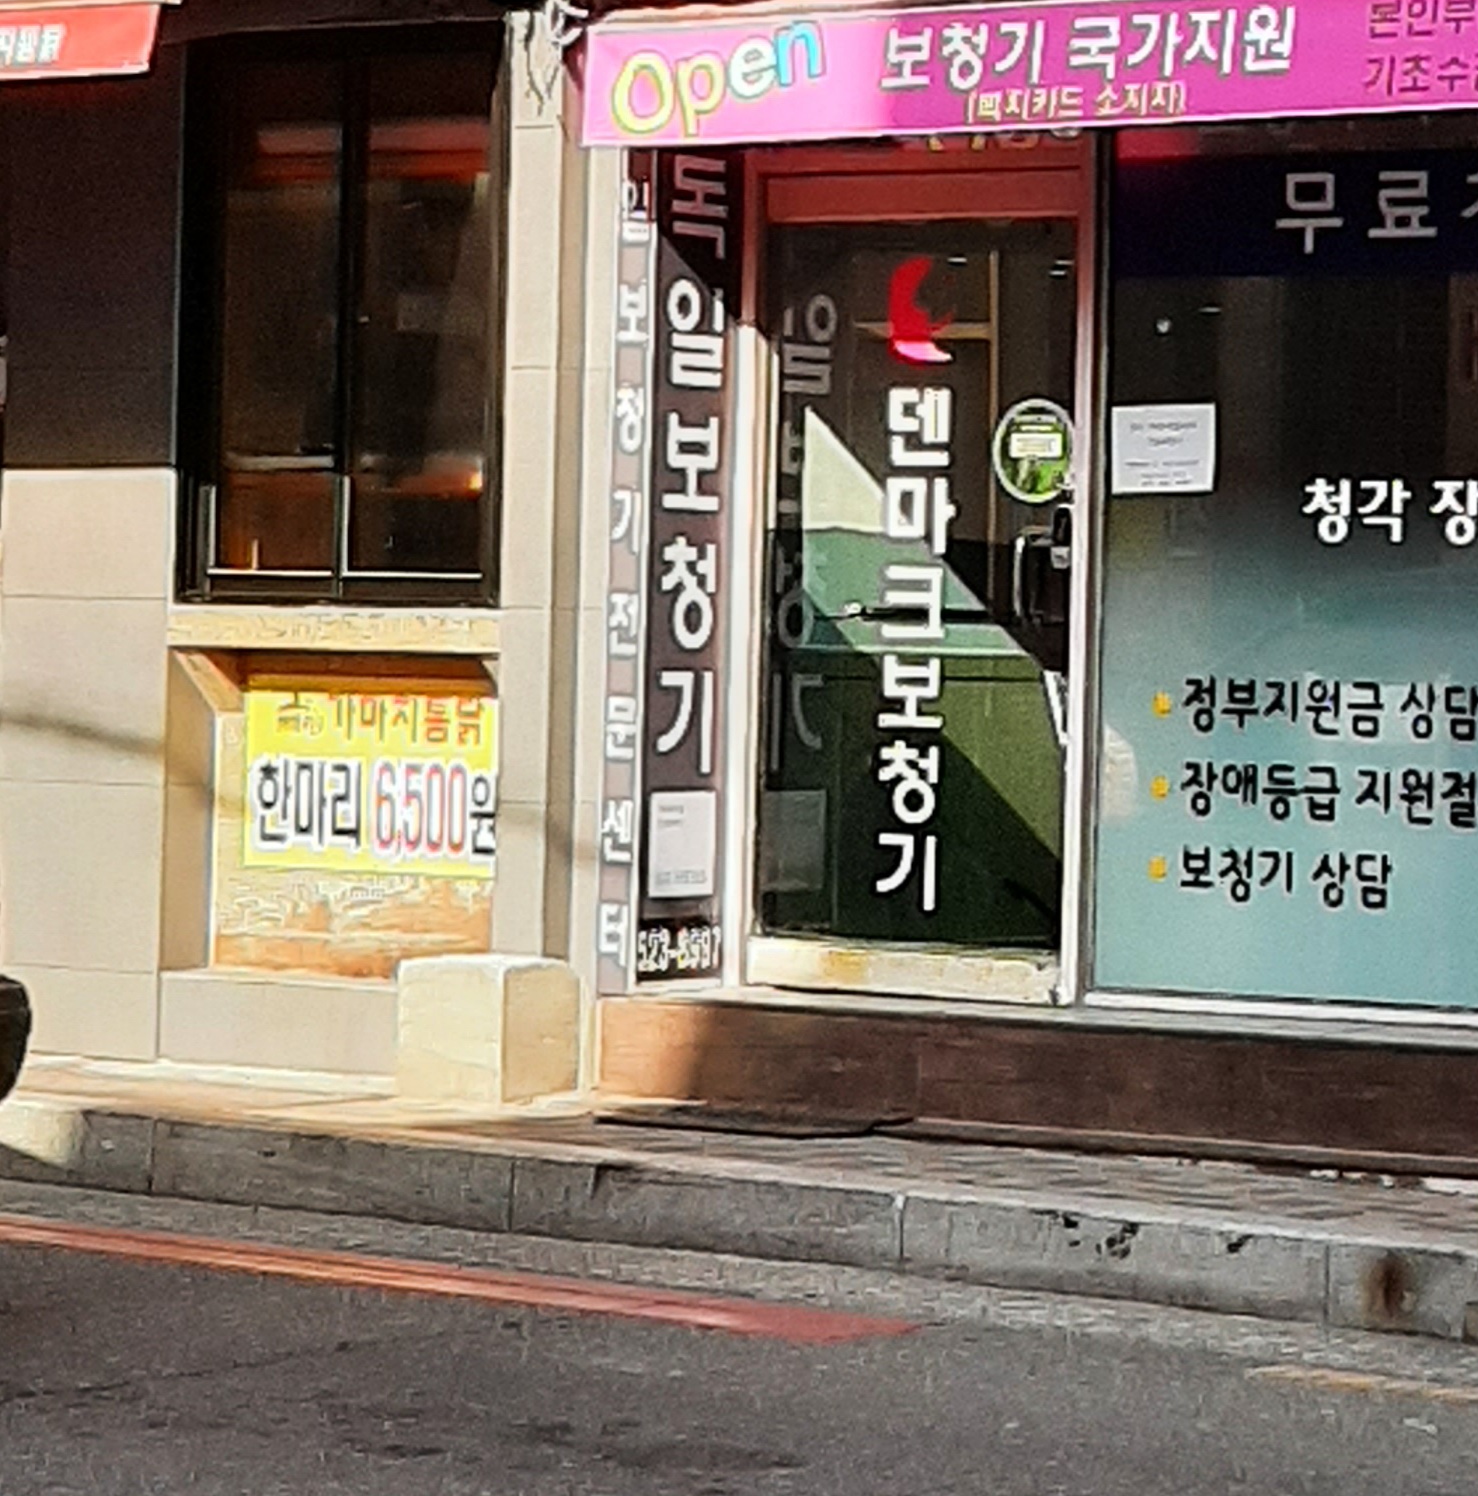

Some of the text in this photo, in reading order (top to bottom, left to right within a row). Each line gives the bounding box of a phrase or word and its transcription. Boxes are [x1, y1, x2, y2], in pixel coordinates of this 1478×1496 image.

[611, 18, 826, 134] Open
[878, 4, 1298, 92] 보청기 국가지원
[658, 154, 727, 776] 독일보청기
[1302, 476, 1411, 547] 청각
[875, 386, 955, 912] 덴마크보청기
[1181, 677, 1387, 737] 정부지원금
[256, 756, 362, 849] 한마리
[1180, 759, 1342, 818] 장애등급
[1180, 847, 1394, 909] 보청기 상담
